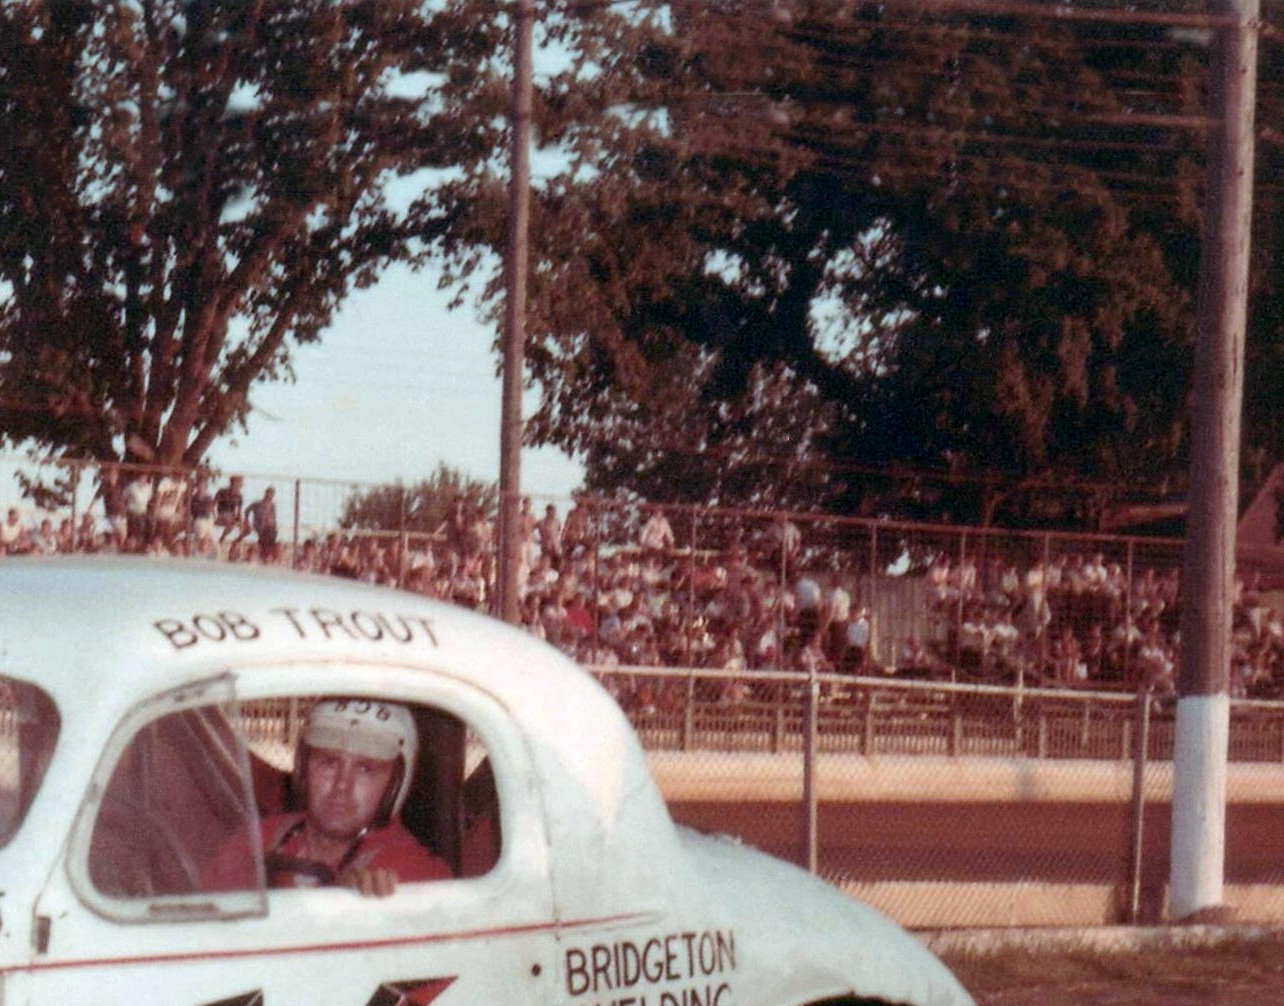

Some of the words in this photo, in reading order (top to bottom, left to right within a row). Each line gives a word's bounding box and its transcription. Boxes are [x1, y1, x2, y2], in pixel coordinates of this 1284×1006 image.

[154, 611, 260, 650] BOB
[271, 608, 439, 647] TROUT
[566, 930, 737, 996] BRIDGETON
